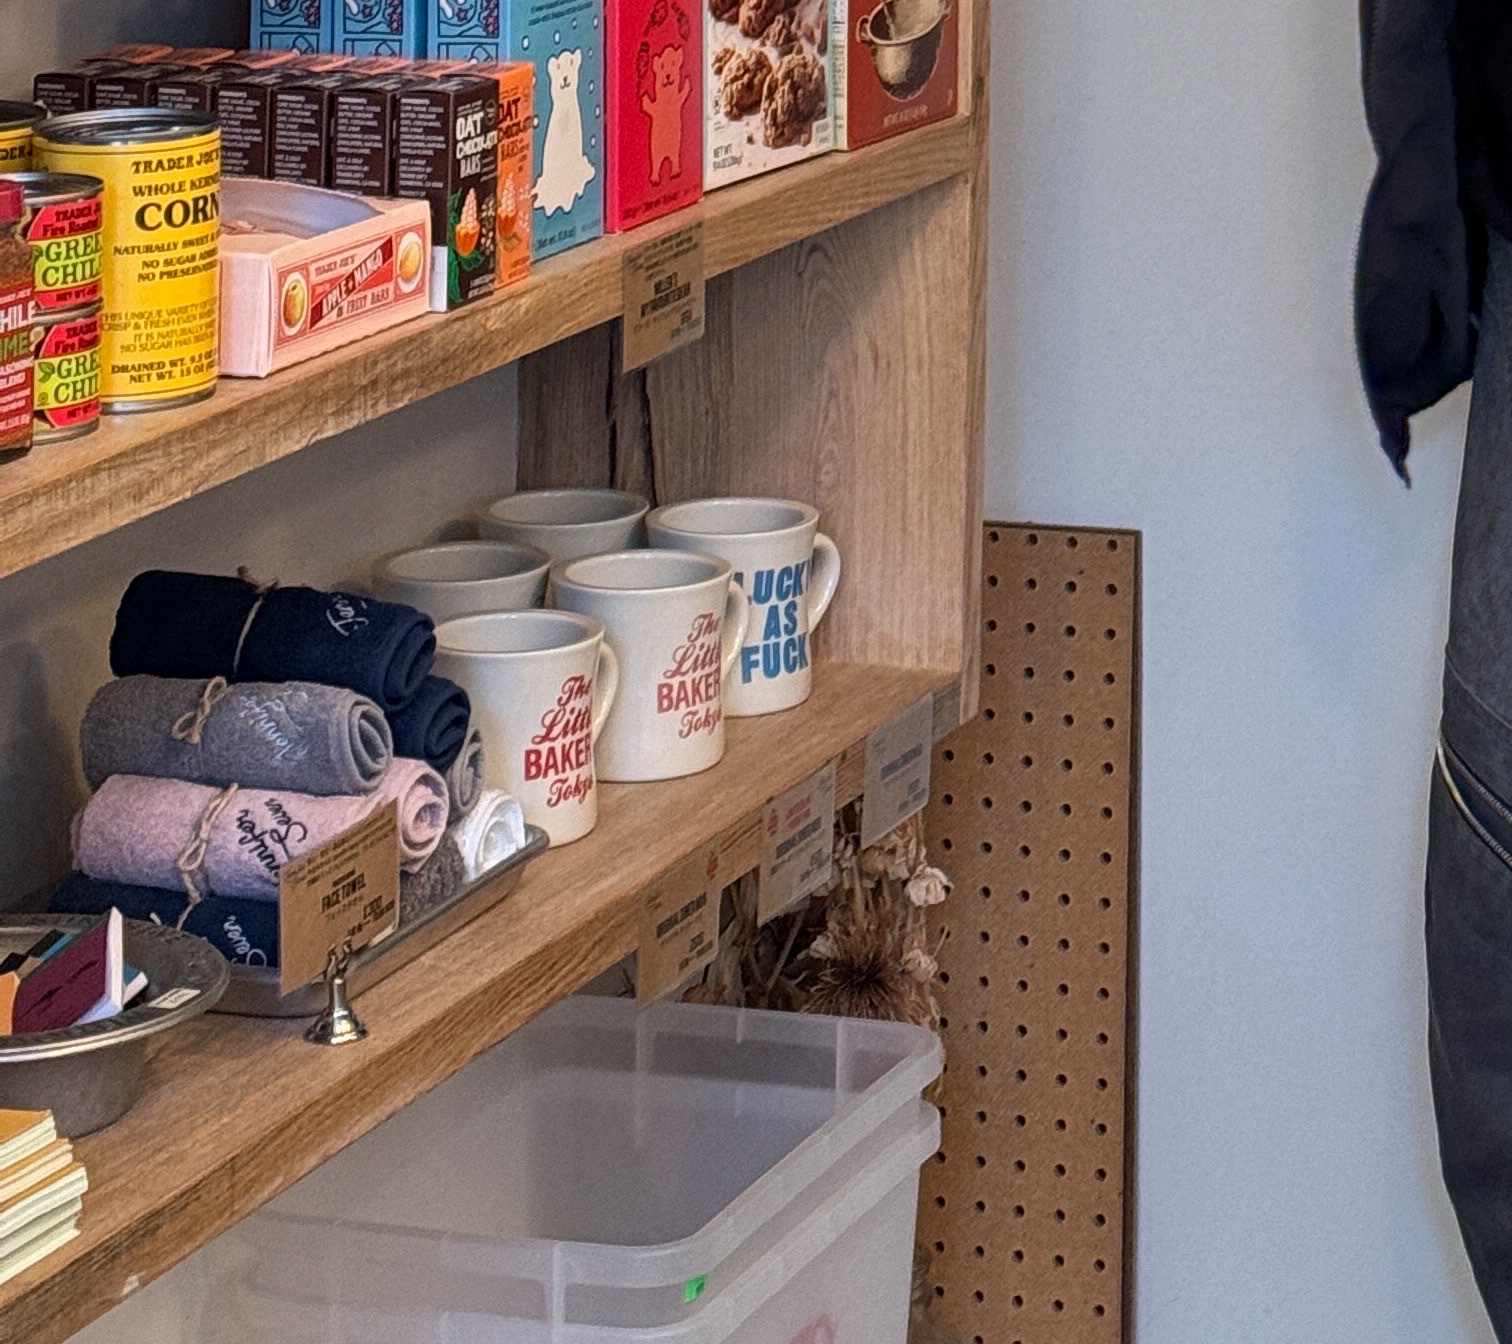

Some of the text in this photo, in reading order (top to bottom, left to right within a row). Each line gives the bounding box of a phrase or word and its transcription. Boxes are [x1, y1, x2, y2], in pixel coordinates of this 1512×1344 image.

[456, 112, 484, 141] OAT
[131, 154, 194, 174] TRADER
[460, 154, 481, 179] BARS
[132, 180, 187, 197] WHOLE
[135, 191, 219, 231] CORN
[113, 240, 180, 256] NATURALLY
[142, 253, 197, 271] NO SUGAR
[137, 271, 156, 283] NO
[111, 360, 167, 374] DRAINED
[129, 373, 153, 385] NET
[762, 599, 798, 642] AS
[740, 633, 809, 685] FUCK
